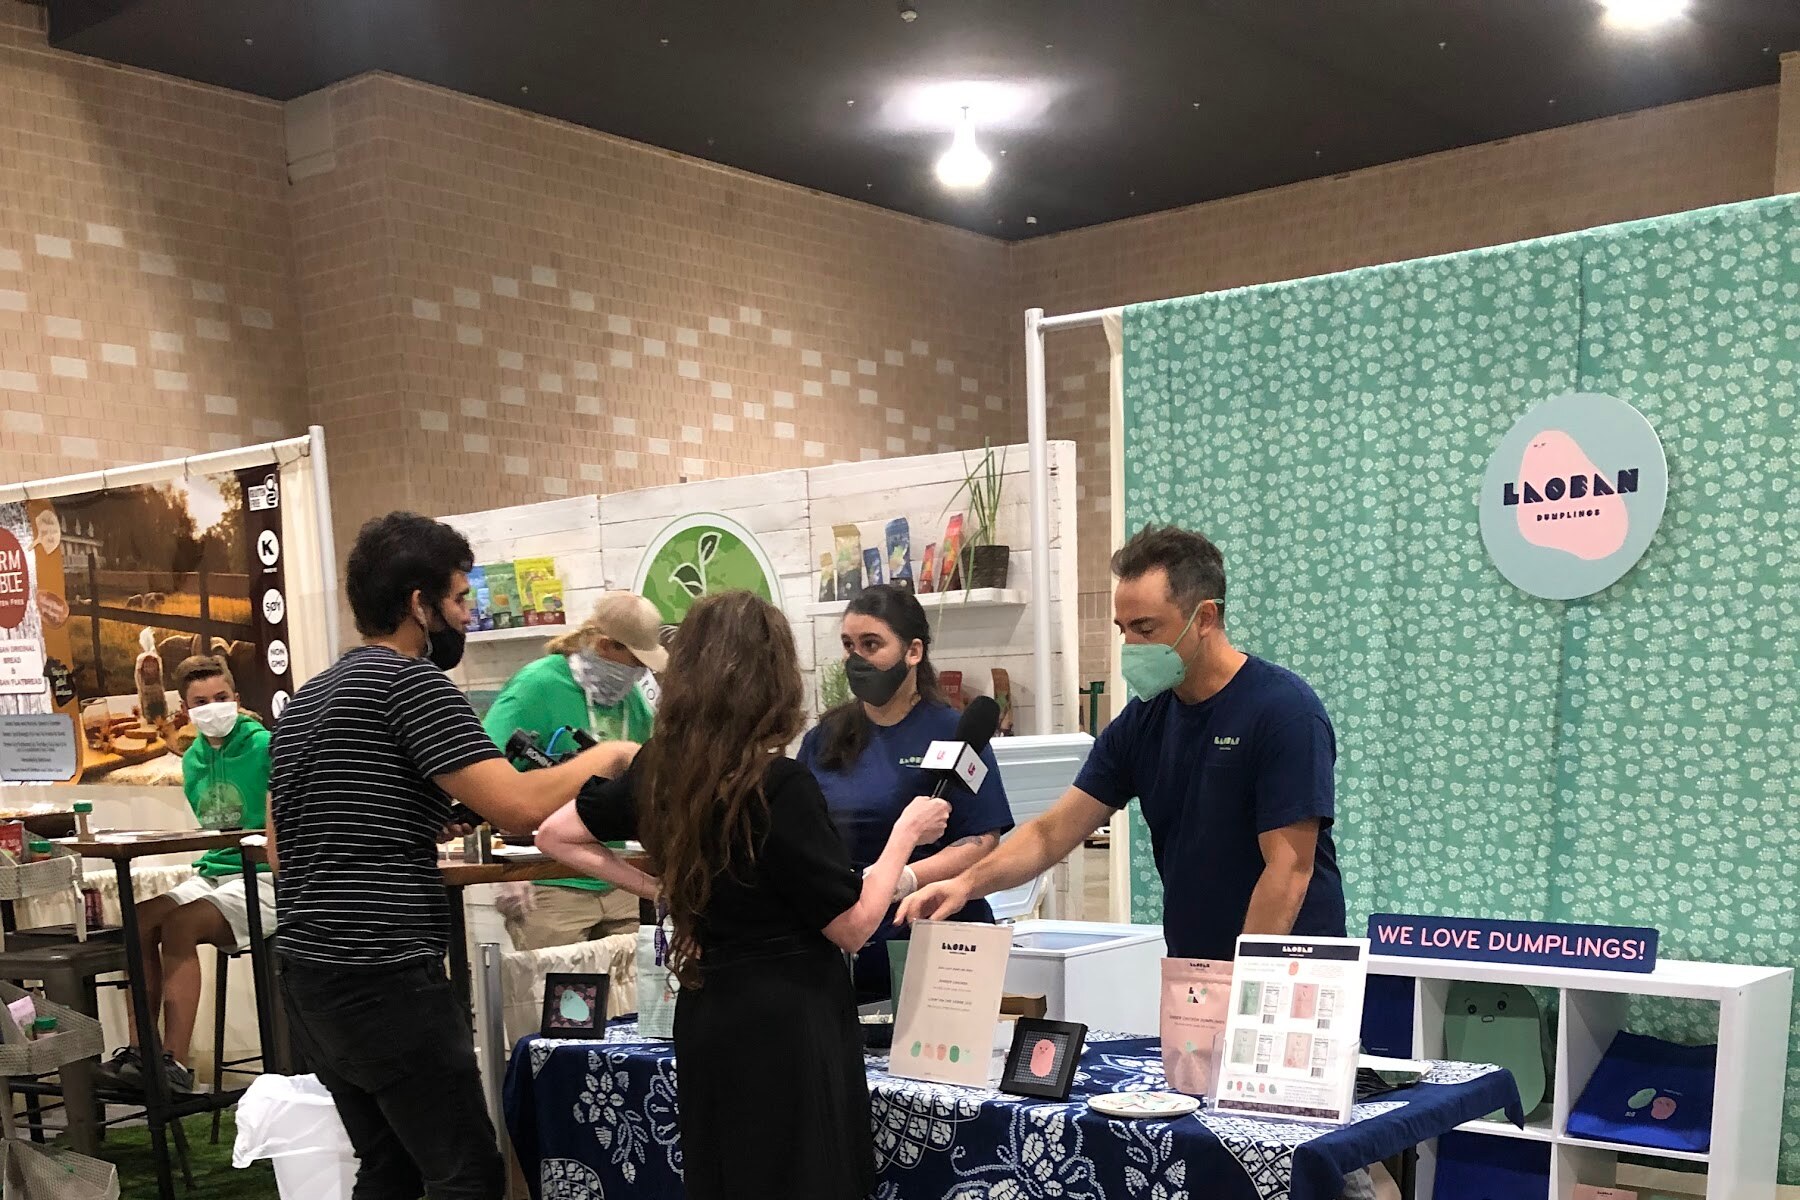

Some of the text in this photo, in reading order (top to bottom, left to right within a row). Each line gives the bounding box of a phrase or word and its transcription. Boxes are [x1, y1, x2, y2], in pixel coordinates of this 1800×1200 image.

[1503, 467, 1639, 506] LAOBAN
[1536, 508, 1601, 522] DUMPLINGS
[261, 539, 275, 557] K
[265, 601, 282, 612] SOY
[270, 648, 285, 656] NON
[271, 660, 286, 668] GMO
[1377, 924, 1646, 961] WE LOVE DUMPLINGS!
